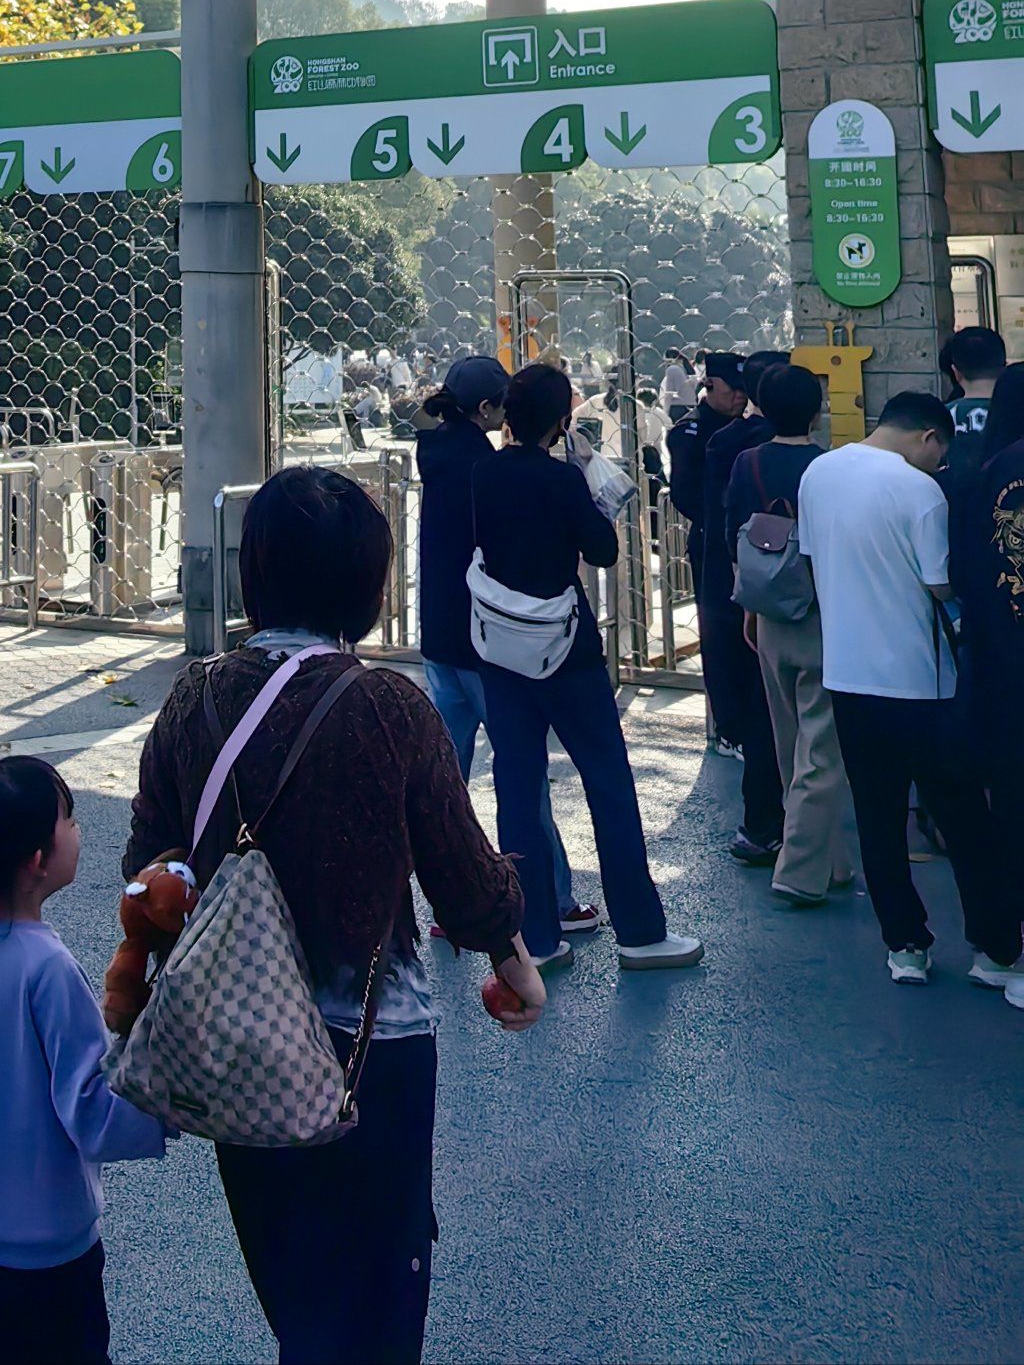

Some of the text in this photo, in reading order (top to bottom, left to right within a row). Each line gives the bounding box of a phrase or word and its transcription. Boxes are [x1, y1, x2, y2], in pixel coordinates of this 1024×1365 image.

[547, 27, 606, 58] 入口
[307, 62, 359, 74] FOREST ZOO
[549, 64, 616, 78] Entrance
[543, 118, 575, 162] 4
[734, 106, 767, 154] 3
[152, 143, 174, 183] 6
[372, 129, 398, 173] 5
[831, 200, 855, 209] Open
